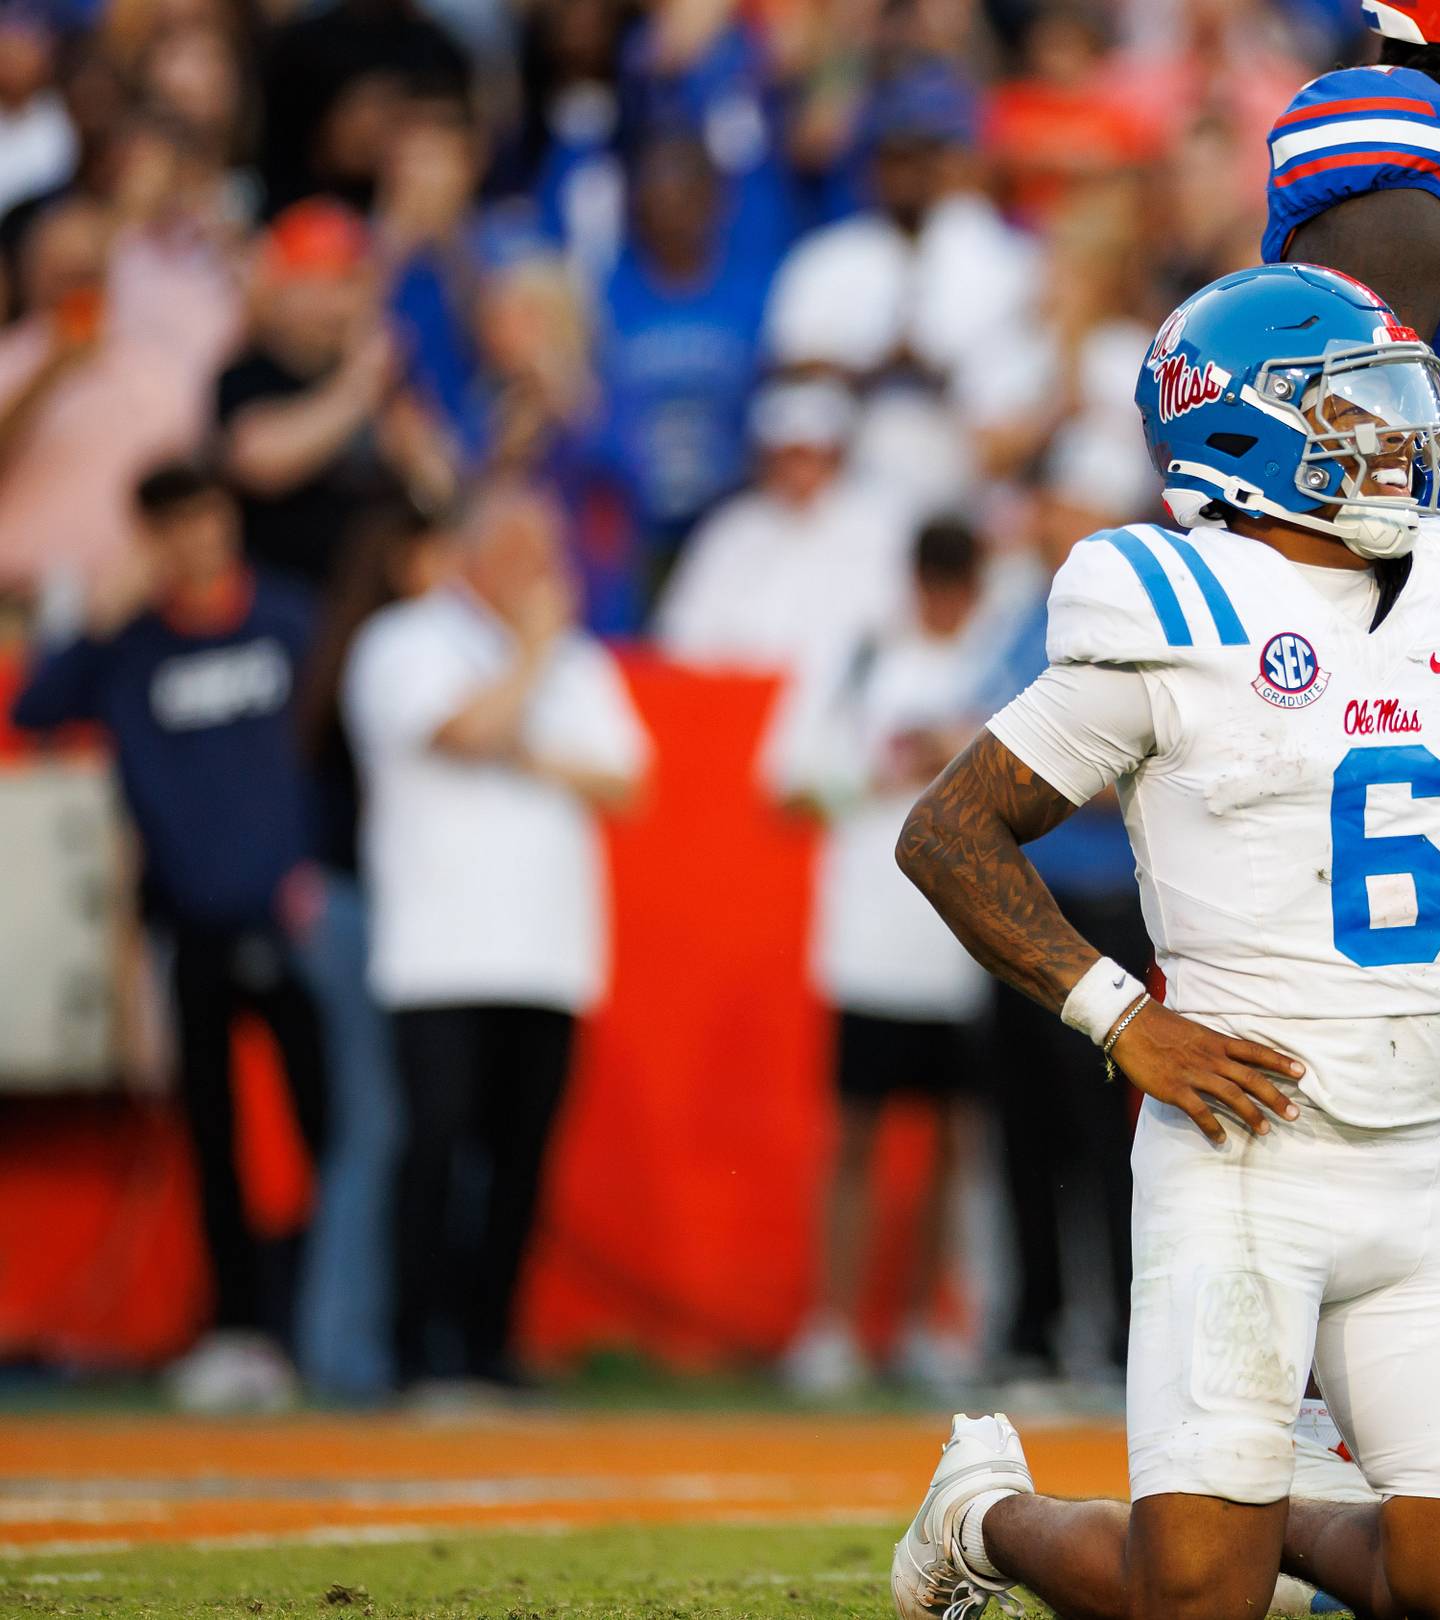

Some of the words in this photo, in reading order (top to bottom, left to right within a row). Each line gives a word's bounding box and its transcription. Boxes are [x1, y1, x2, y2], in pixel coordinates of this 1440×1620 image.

[1154, 352, 1223, 424] Miss
[1265, 635, 1314, 690] SEC
[1262, 682, 1324, 708] GRADUATE
[1344, 699, 1374, 735] Ole
[1373, 698, 1422, 733] Miss
